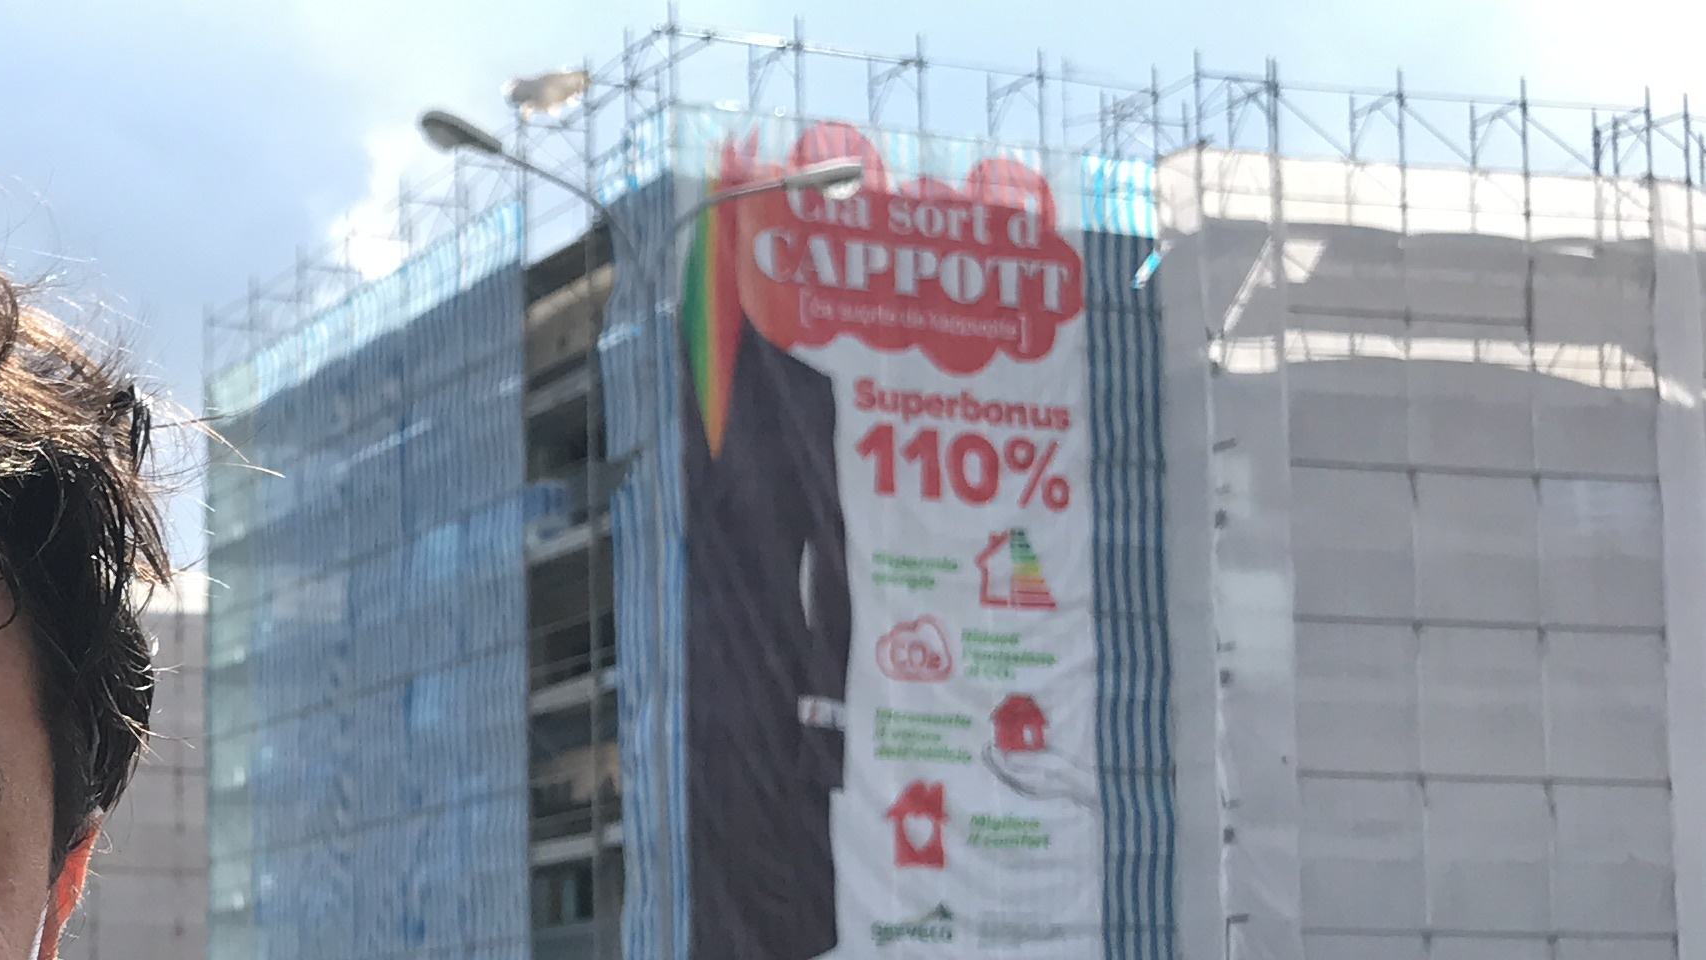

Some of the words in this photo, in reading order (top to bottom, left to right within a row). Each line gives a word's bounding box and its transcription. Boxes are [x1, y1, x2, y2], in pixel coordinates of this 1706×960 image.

[753, 228, 1069, 313] CAPPOTT
[854, 377, 1071, 430] Superbonus
[855, 422, 1070, 513] 110%
